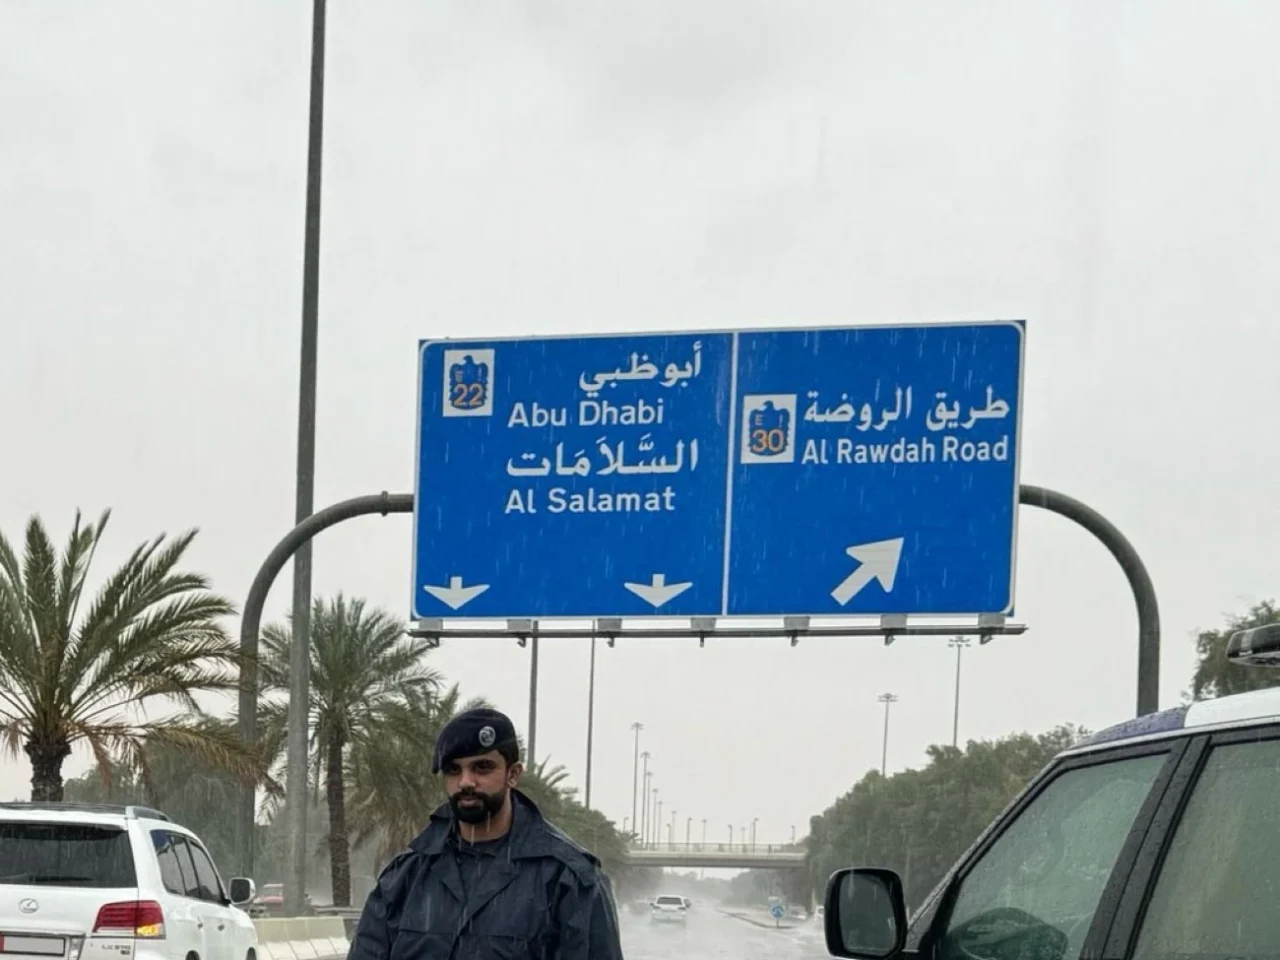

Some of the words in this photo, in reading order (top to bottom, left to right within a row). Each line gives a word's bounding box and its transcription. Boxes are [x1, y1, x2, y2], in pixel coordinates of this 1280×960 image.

[453, 383, 483, 406] 22
[804, 385, 913, 431] الروضة
[926, 385, 1010, 431] طريق
[508, 402, 567, 429] Abu
[579, 398, 664, 428] Dhabi
[752, 428, 784, 453] 30
[801, 439, 829, 465] Al
[837, 436, 936, 464] Rawdah
[942, 434, 1009, 462] Road
[505, 489, 537, 514] Al
[547, 486, 676, 514] Salamat
